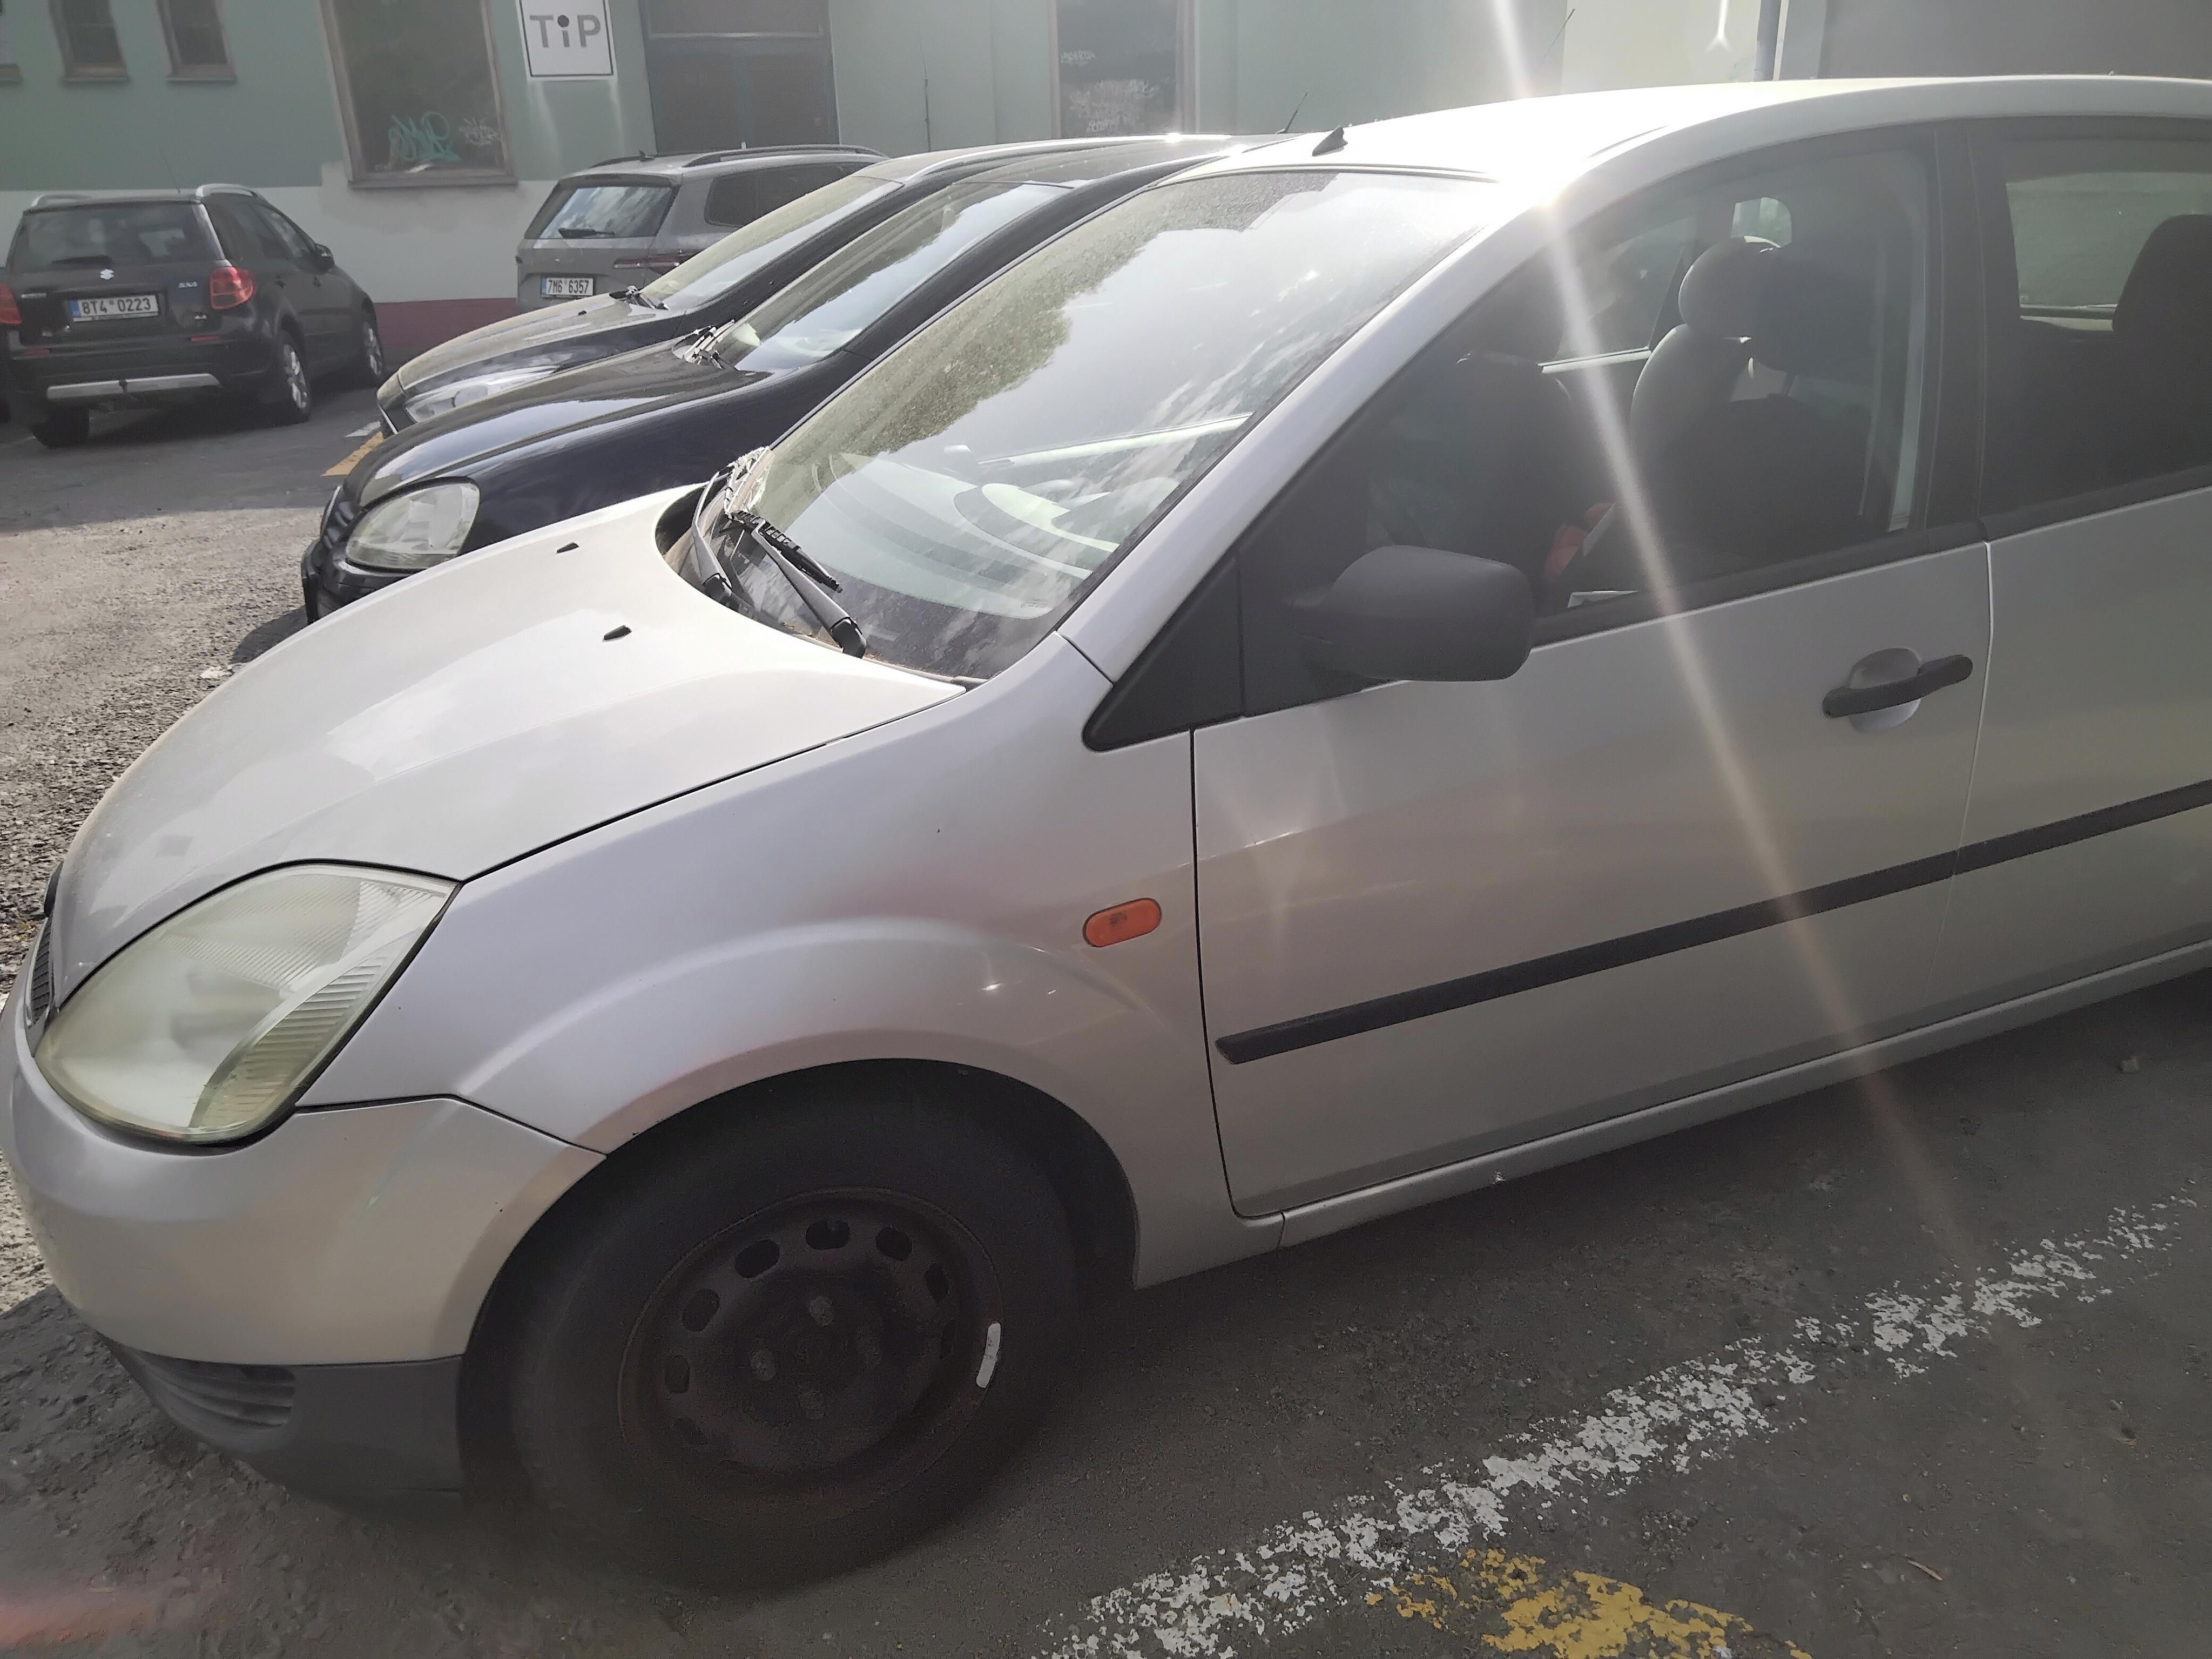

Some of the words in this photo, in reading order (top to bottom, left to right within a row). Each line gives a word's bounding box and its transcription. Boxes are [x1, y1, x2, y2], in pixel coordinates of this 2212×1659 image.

[529, 15, 601, 48] TiP
[548, 279, 563, 293] 7M6
[568, 280, 589, 294] 6357
[82, 300, 107, 315] 8T4
[117, 298, 151, 312] 0223
